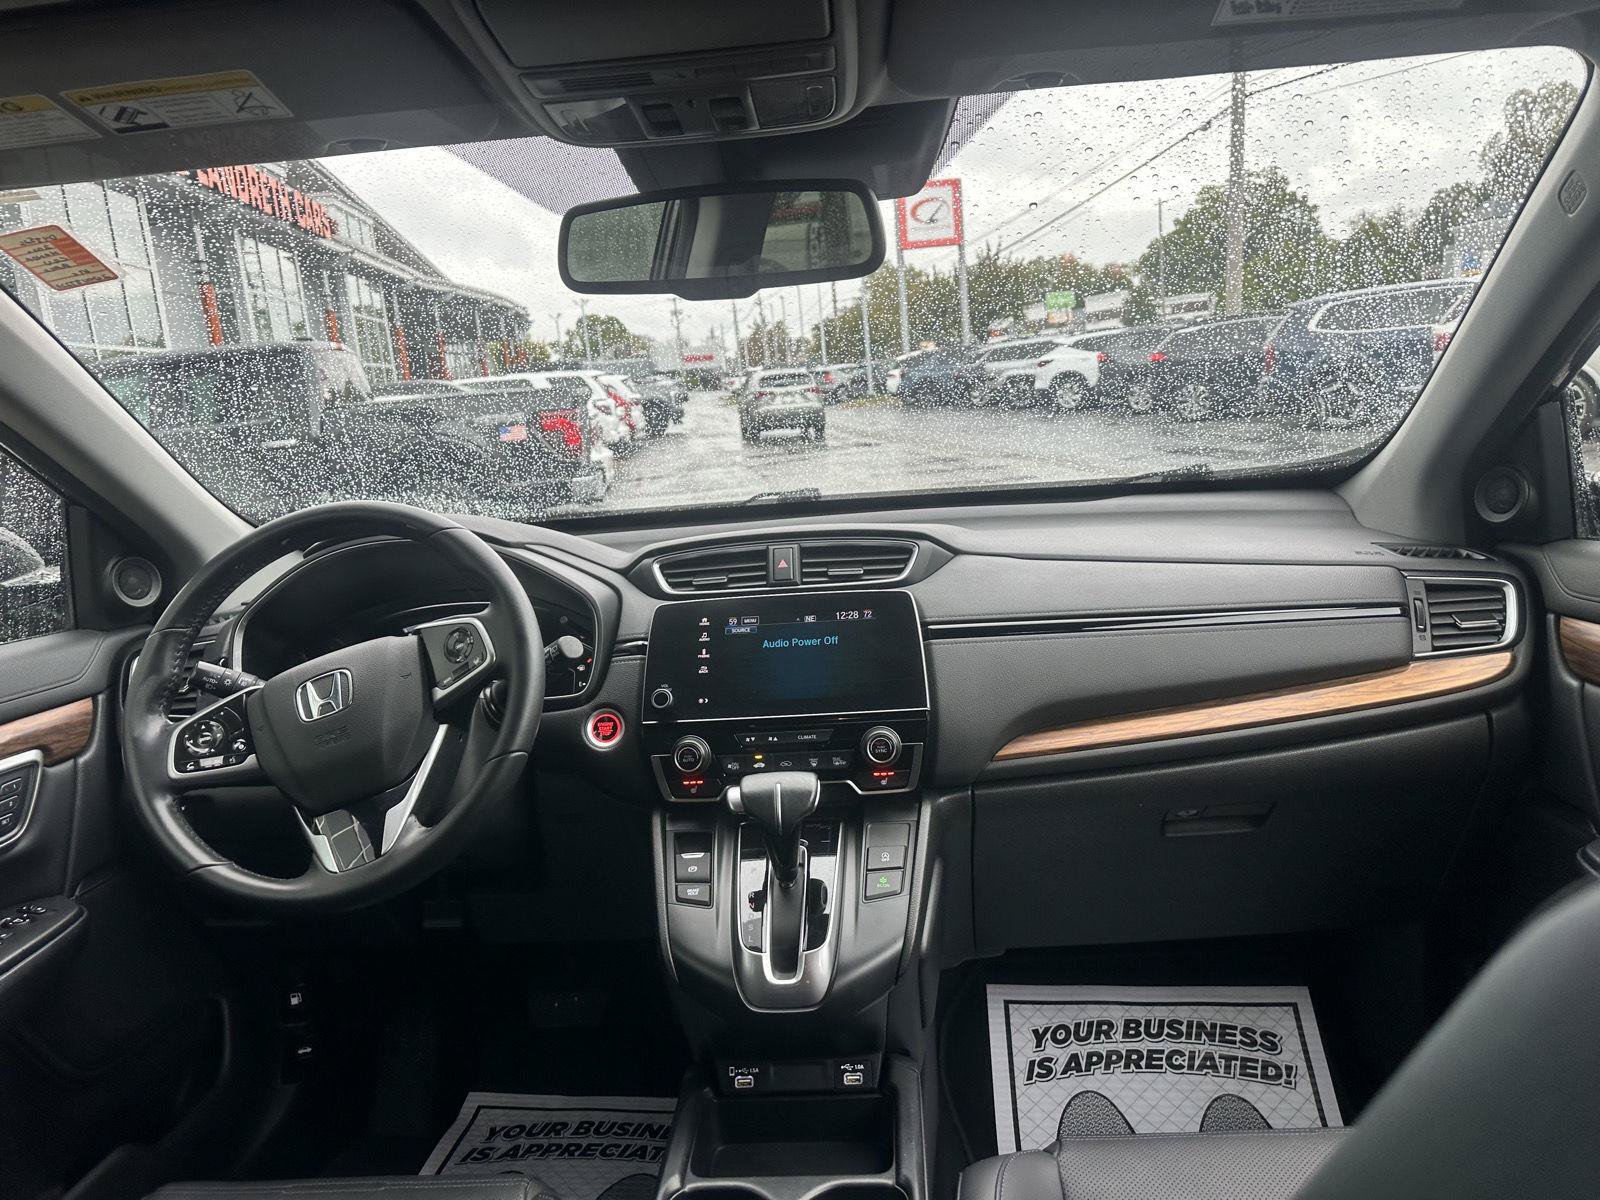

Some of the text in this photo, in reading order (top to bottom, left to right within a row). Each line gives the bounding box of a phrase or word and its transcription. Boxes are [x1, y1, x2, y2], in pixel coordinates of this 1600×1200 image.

[293, 190, 332, 239] CARS
[728, 617, 738, 626] 59
[835, 610, 872, 620] 12:28 72
[763, 635, 839, 648] Audio Power Off
[1030, 1018, 1282, 1053] YOUR BUSINESS
[1025, 1049, 1296, 1087] IS APPRECIATED!
[482, 1121, 570, 1142] YOUR
[456, 1146, 492, 1165] IS
